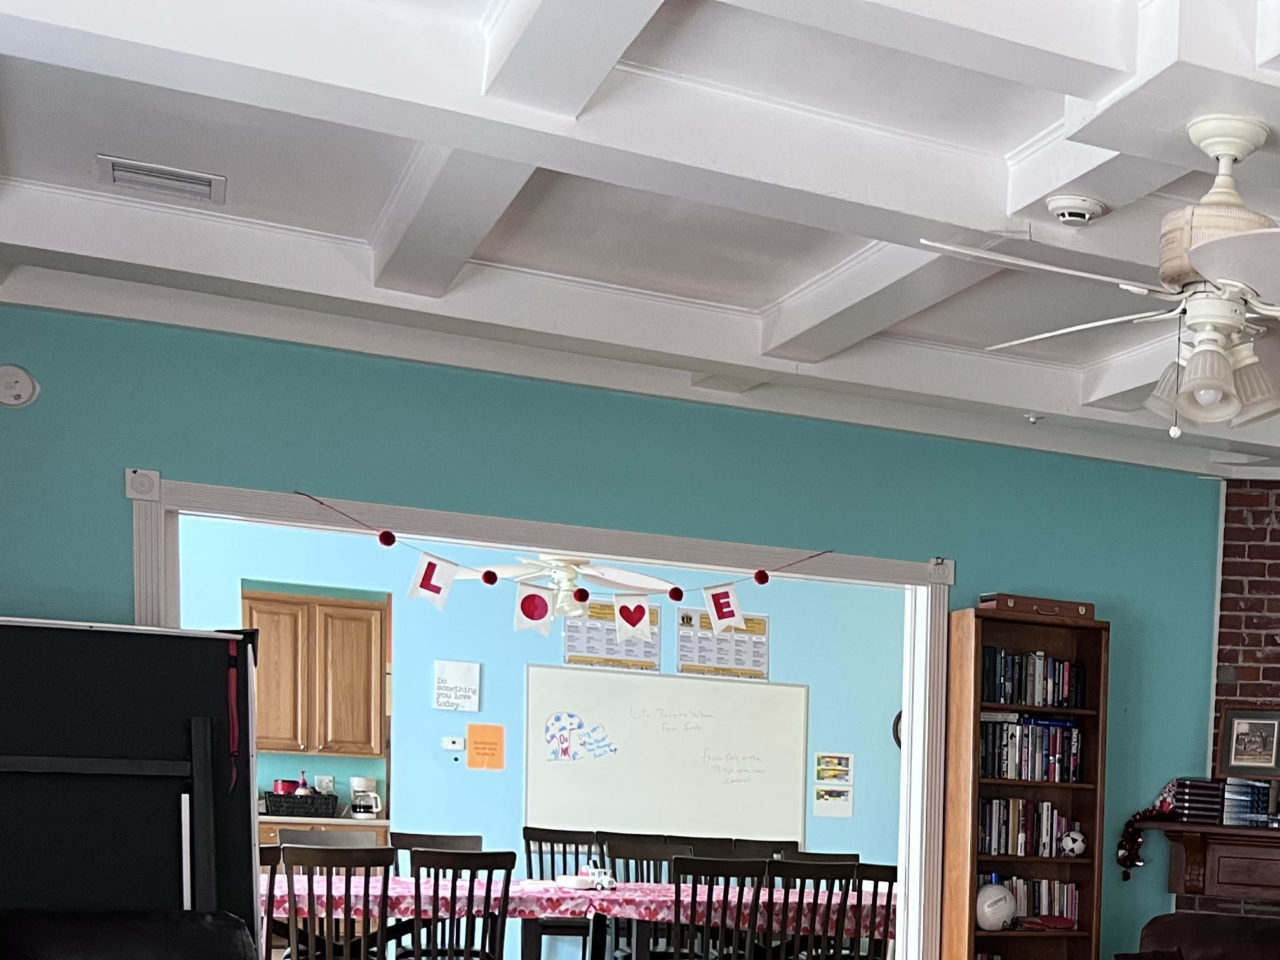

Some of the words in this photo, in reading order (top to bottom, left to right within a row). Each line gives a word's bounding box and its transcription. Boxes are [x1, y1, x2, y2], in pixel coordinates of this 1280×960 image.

[436, 677, 448, 685] Do
[436, 684, 478, 696] something
[436, 691, 452, 700] you
[454, 691, 472, 700] love
